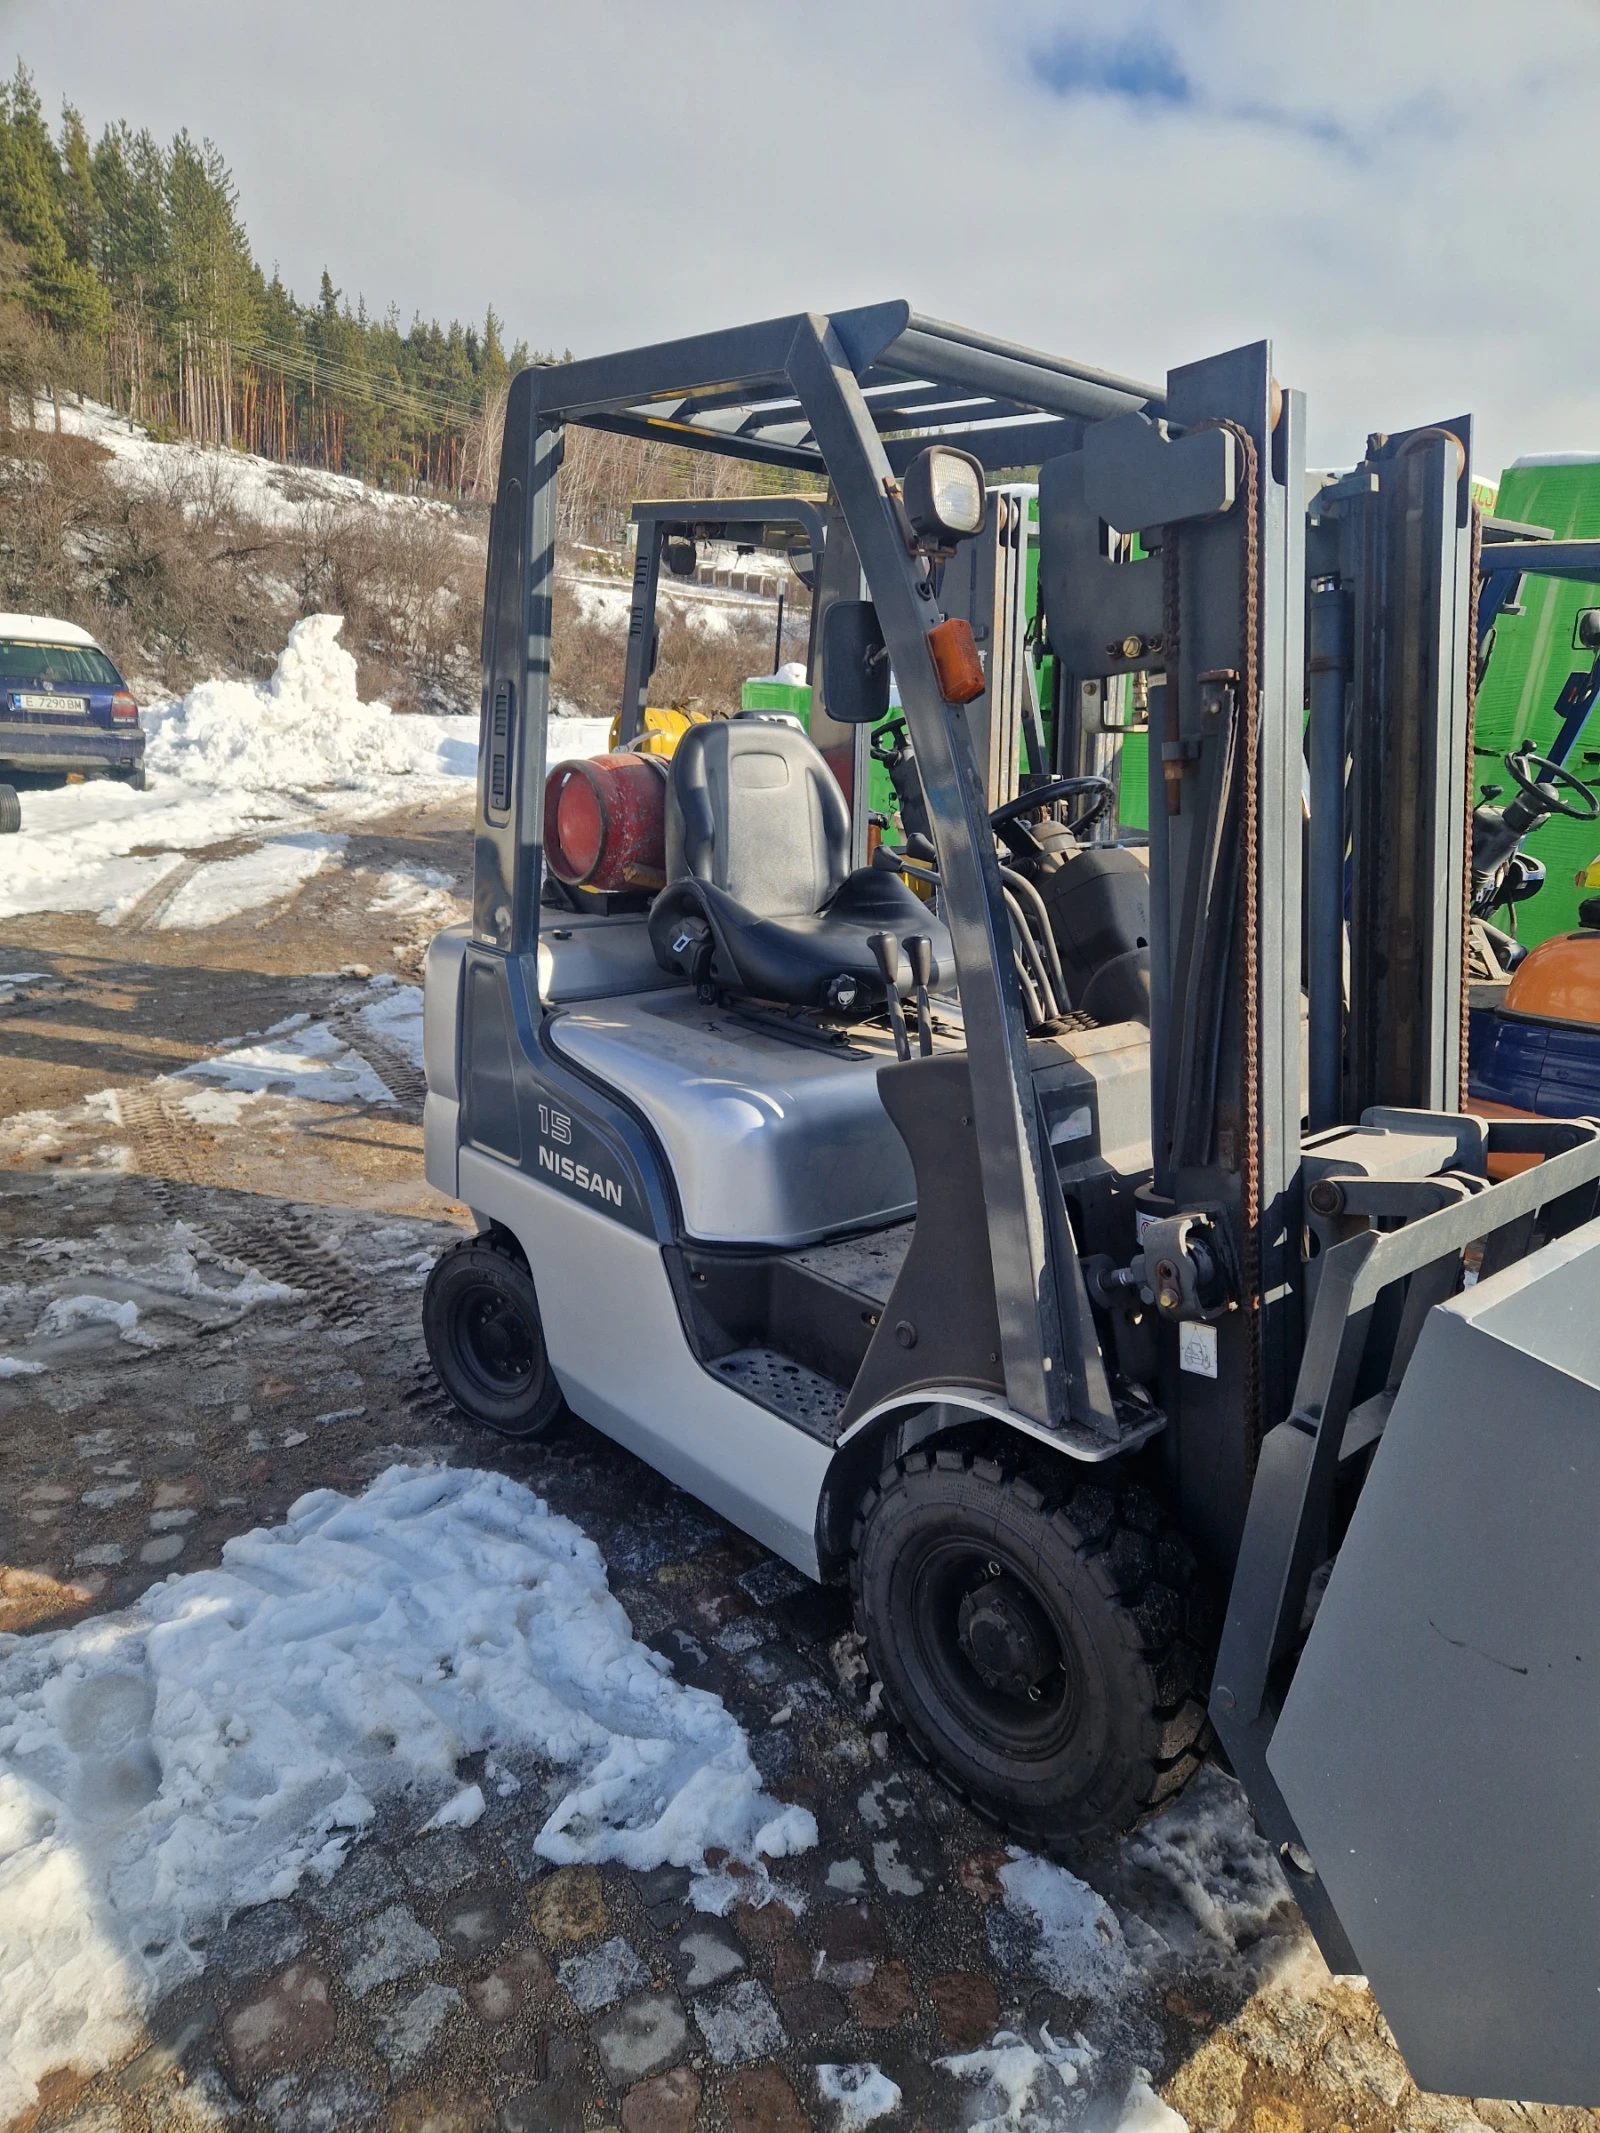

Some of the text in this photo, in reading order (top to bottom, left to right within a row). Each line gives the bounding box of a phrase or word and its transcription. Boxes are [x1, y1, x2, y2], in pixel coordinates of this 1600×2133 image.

[26, 697, 82, 710] E 7290 BM
[538, 1104, 571, 1145] 15
[539, 1145, 622, 1207] NISSAN
